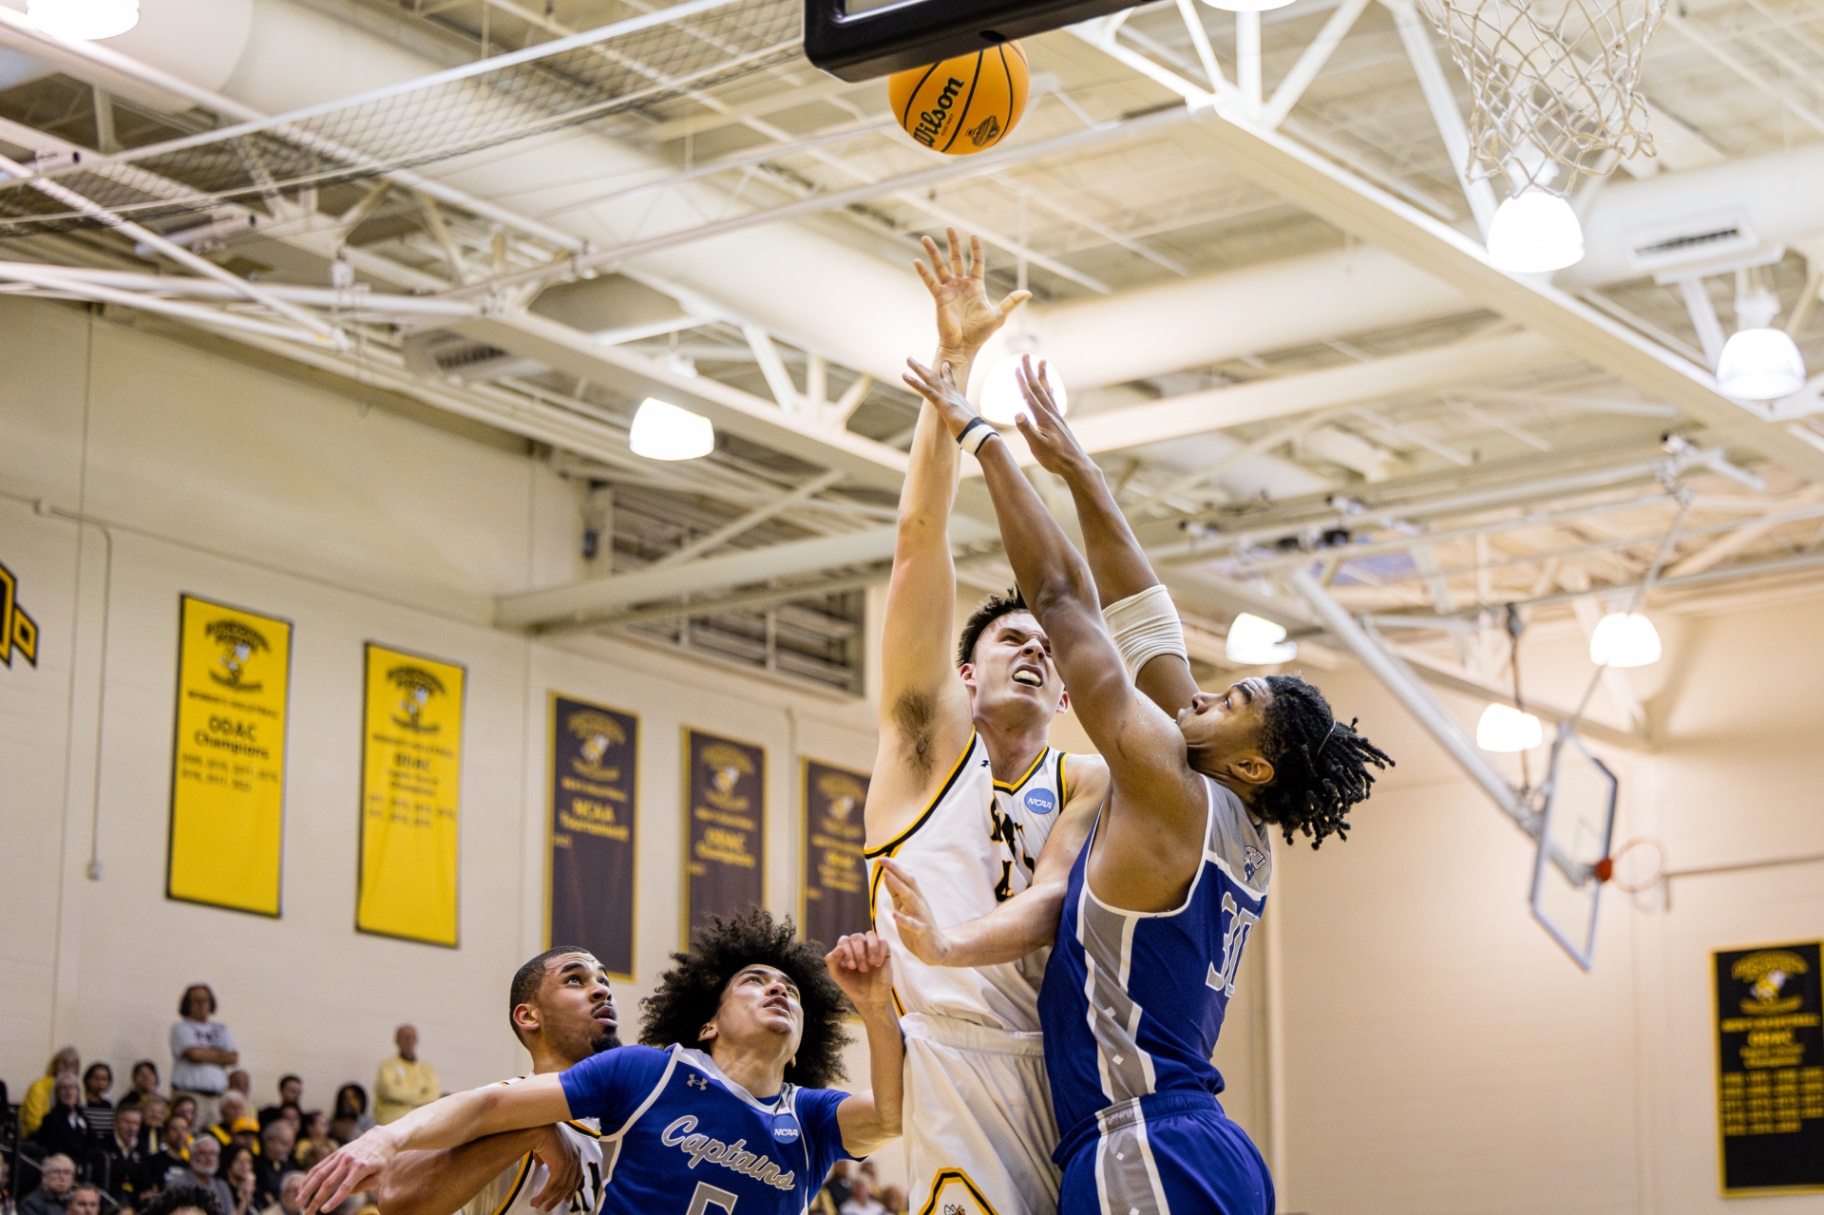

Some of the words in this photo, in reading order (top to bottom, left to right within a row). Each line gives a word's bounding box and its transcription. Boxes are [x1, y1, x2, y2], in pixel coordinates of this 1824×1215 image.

[913, 77, 964, 148] Wilson
[1027, 797, 1053, 809] NCAA
[661, 1115, 795, 1190] Captains
[774, 1128, 799, 1137] NCAA
